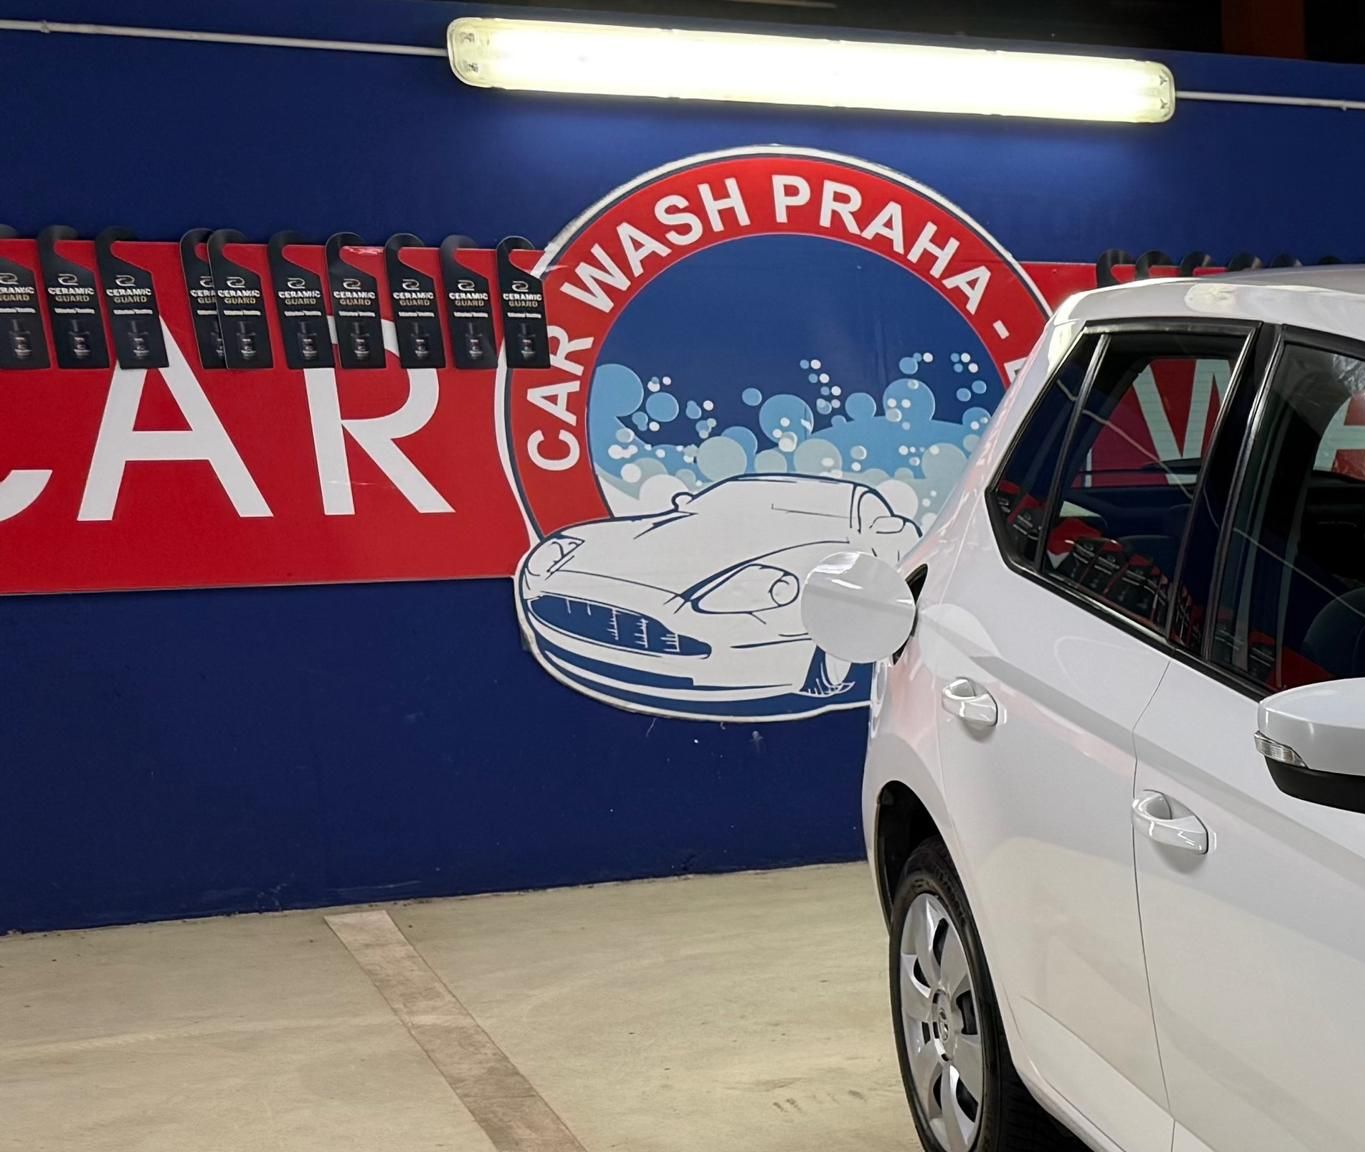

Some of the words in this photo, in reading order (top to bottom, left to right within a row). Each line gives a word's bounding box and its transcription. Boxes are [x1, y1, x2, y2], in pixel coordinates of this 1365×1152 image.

[559, 176, 749, 314] WASH
[771, 174, 999, 316] PRAHA
[48, 287, 94, 296] CERAMIC
[106, 288, 151, 297] CERAMIC
[217, 290, 261, 298] CERAMIC
[278, 290, 321, 299] CERAMIC
[333, 290, 376, 300] CERAMIC
[393, 291, 434, 300] CERAMIC
[449, 292, 488, 300] CERAMIC
[502, 293, 542, 302] CERAMIC
[526, 324, 594, 472] CAR
